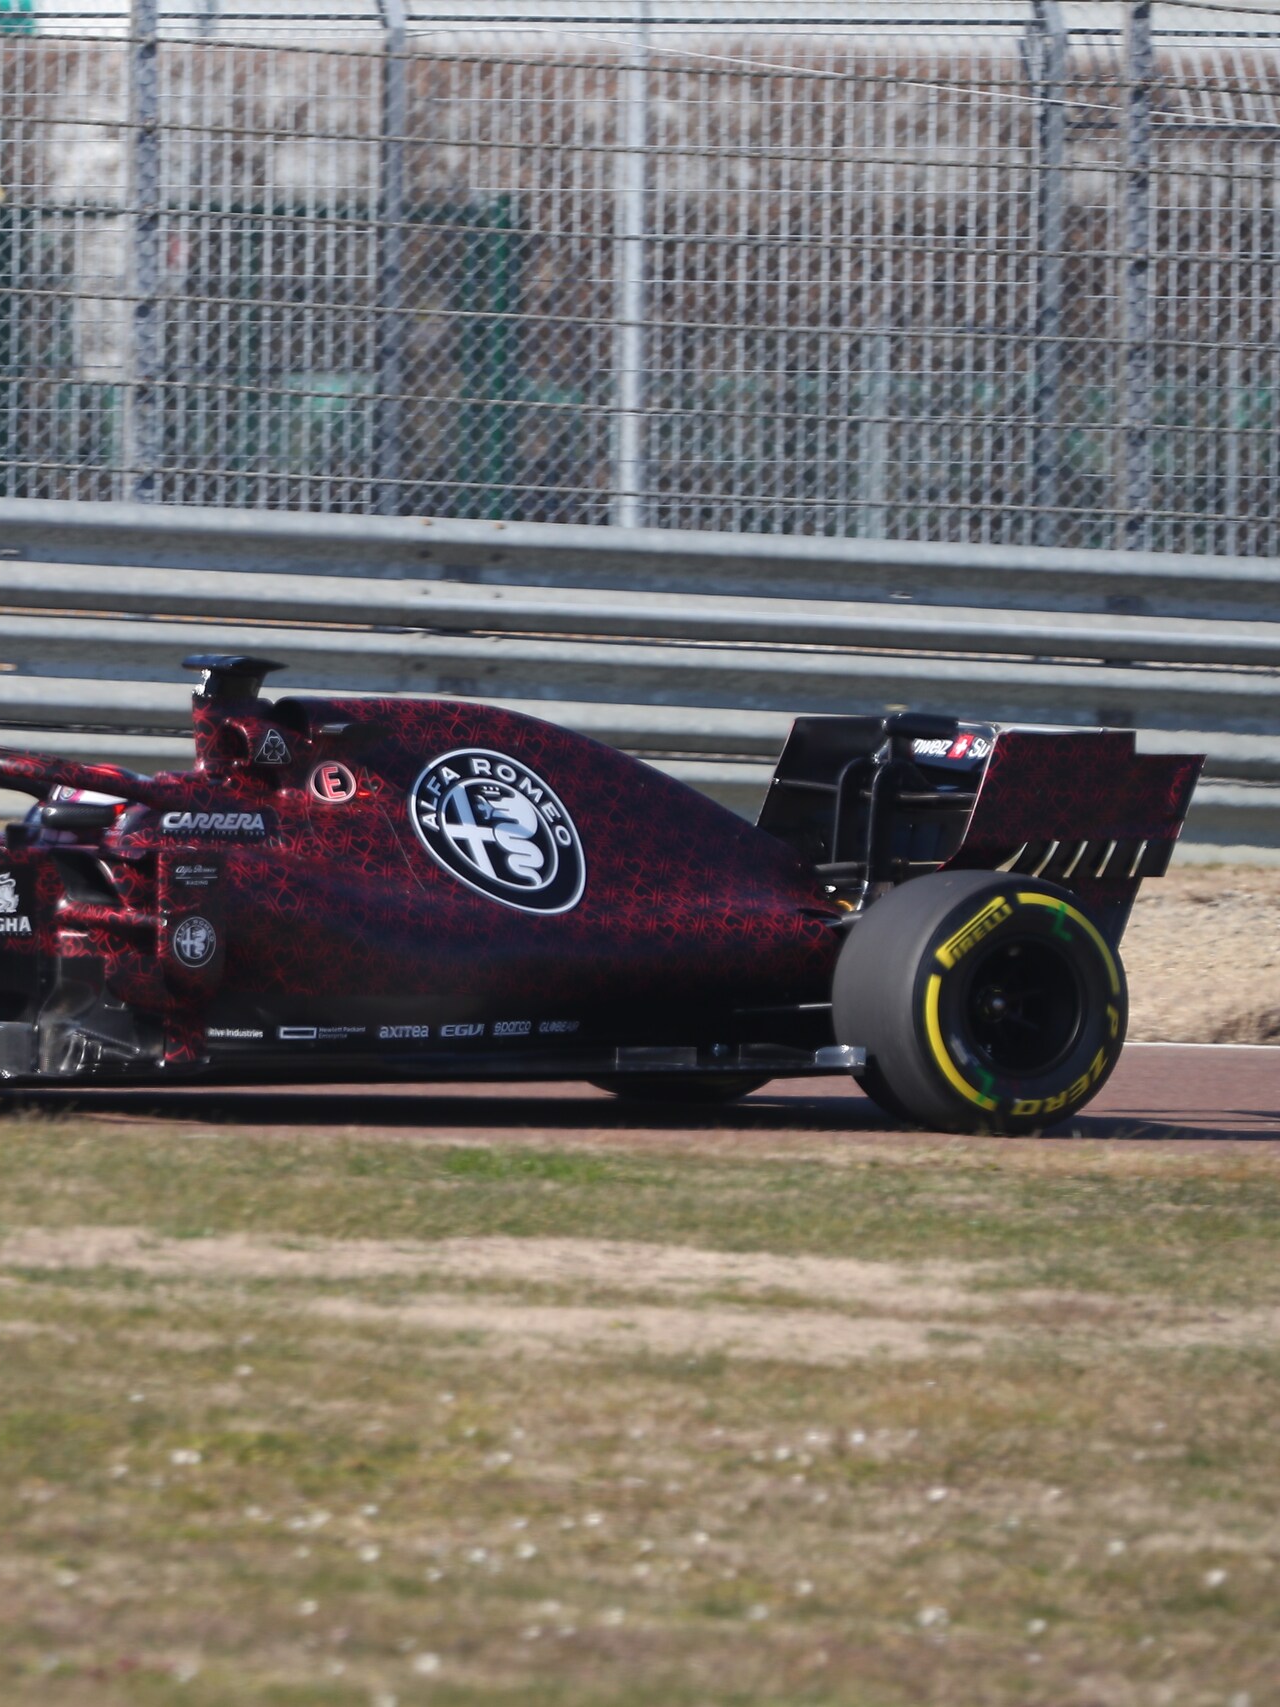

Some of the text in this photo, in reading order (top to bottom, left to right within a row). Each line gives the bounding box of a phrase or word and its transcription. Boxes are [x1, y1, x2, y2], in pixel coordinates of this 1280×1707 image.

[969, 738, 990, 758] Su
[162, 811, 265, 830] CARRERA
[422, 758, 572, 846] ALFA ROMEO
[935, 896, 1013, 970] PIRELLI
[494, 1021, 532, 1034] sparco
[1010, 1046, 1109, 1116] ZERO
